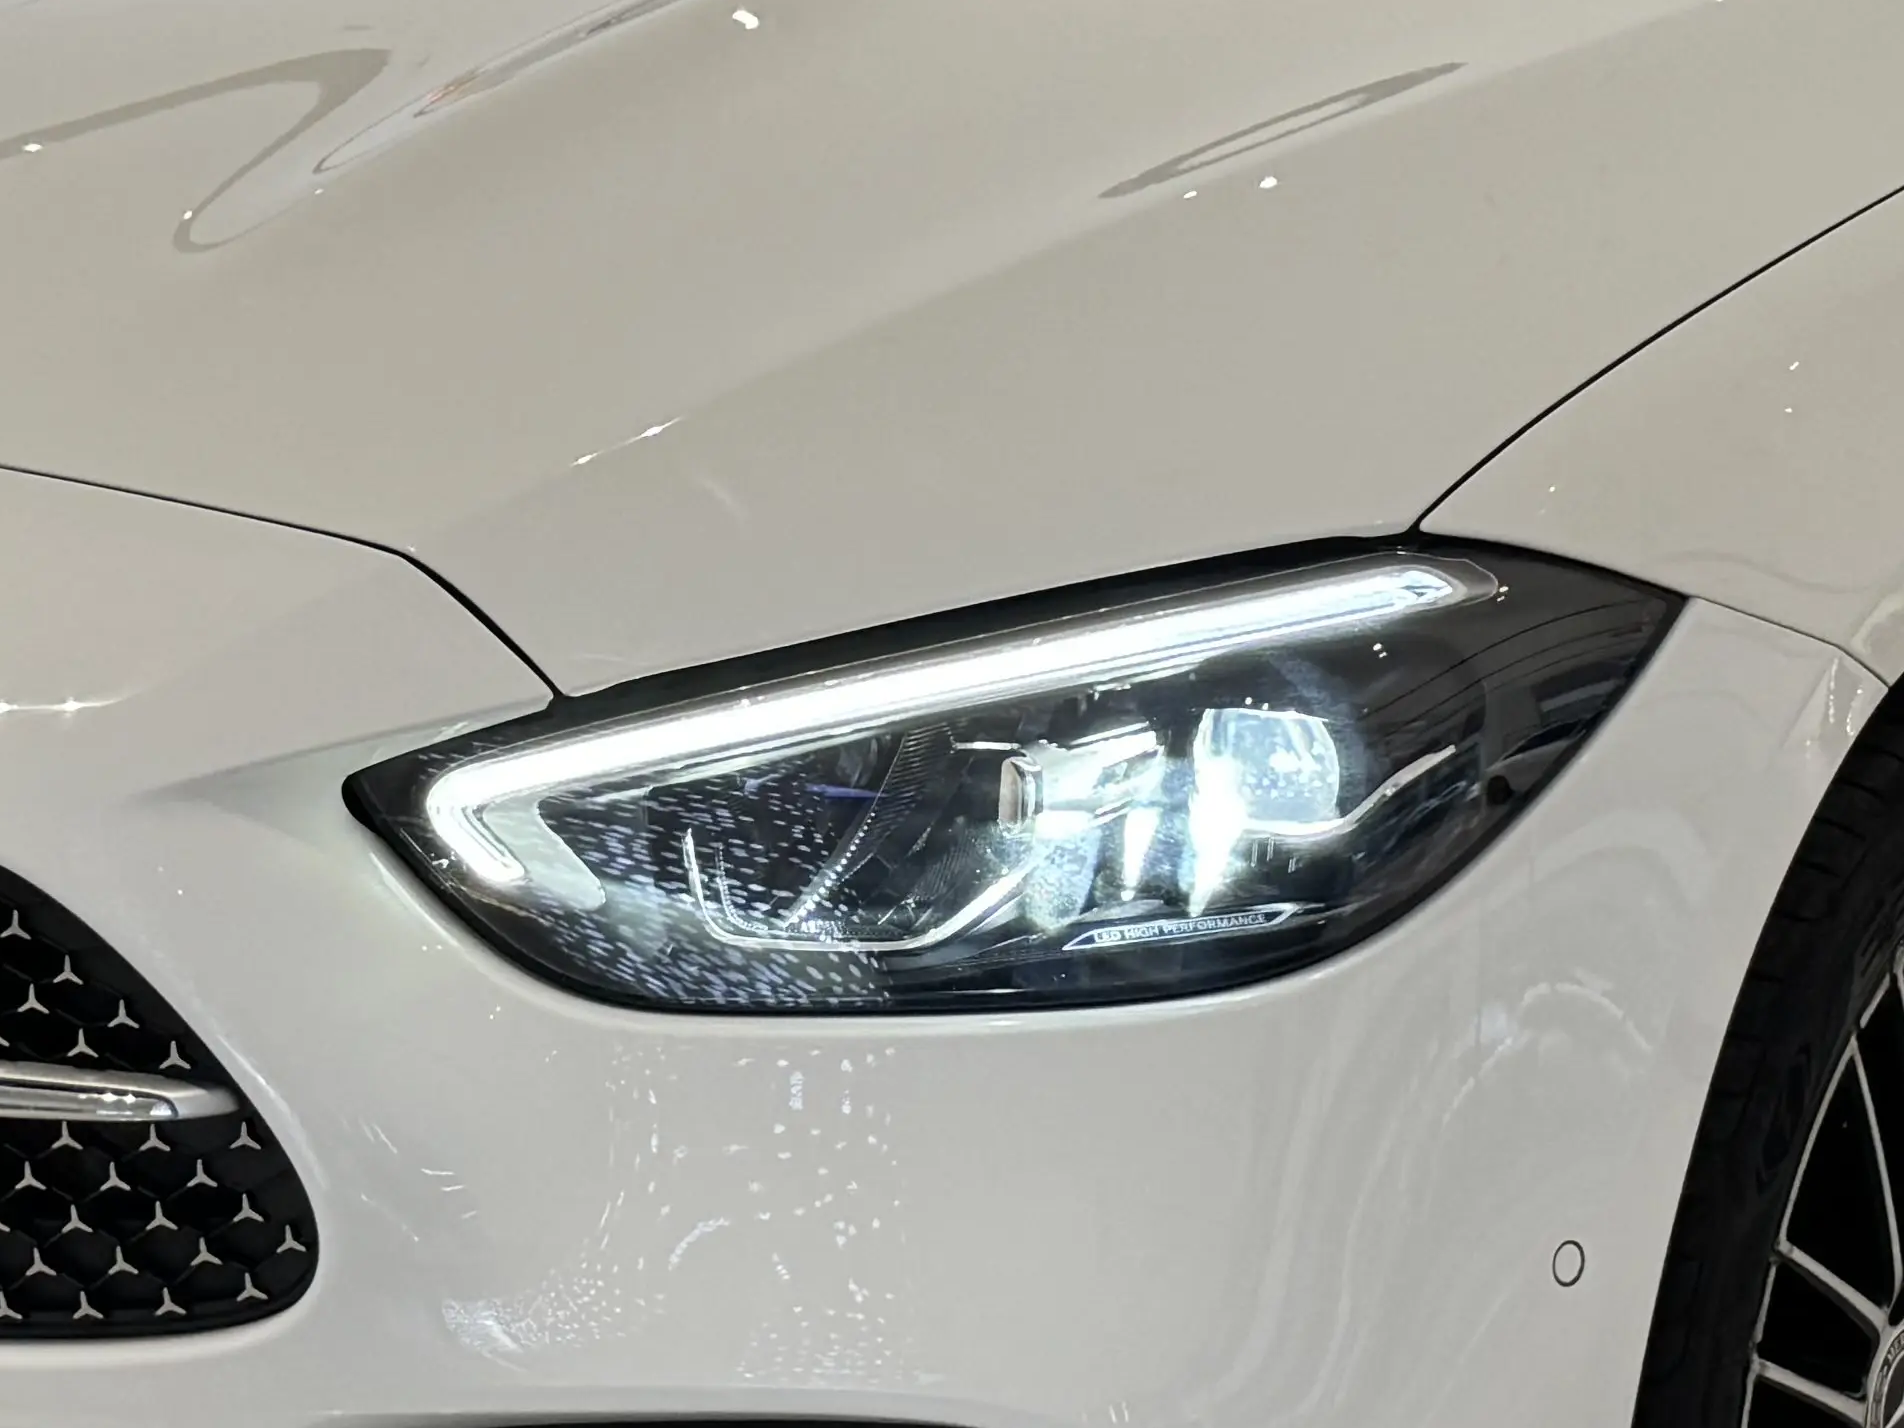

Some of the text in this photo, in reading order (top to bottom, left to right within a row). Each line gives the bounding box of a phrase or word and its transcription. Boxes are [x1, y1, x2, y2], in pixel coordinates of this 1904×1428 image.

[1095, 914, 1266, 943] LED HIGH PERFORMANCE
